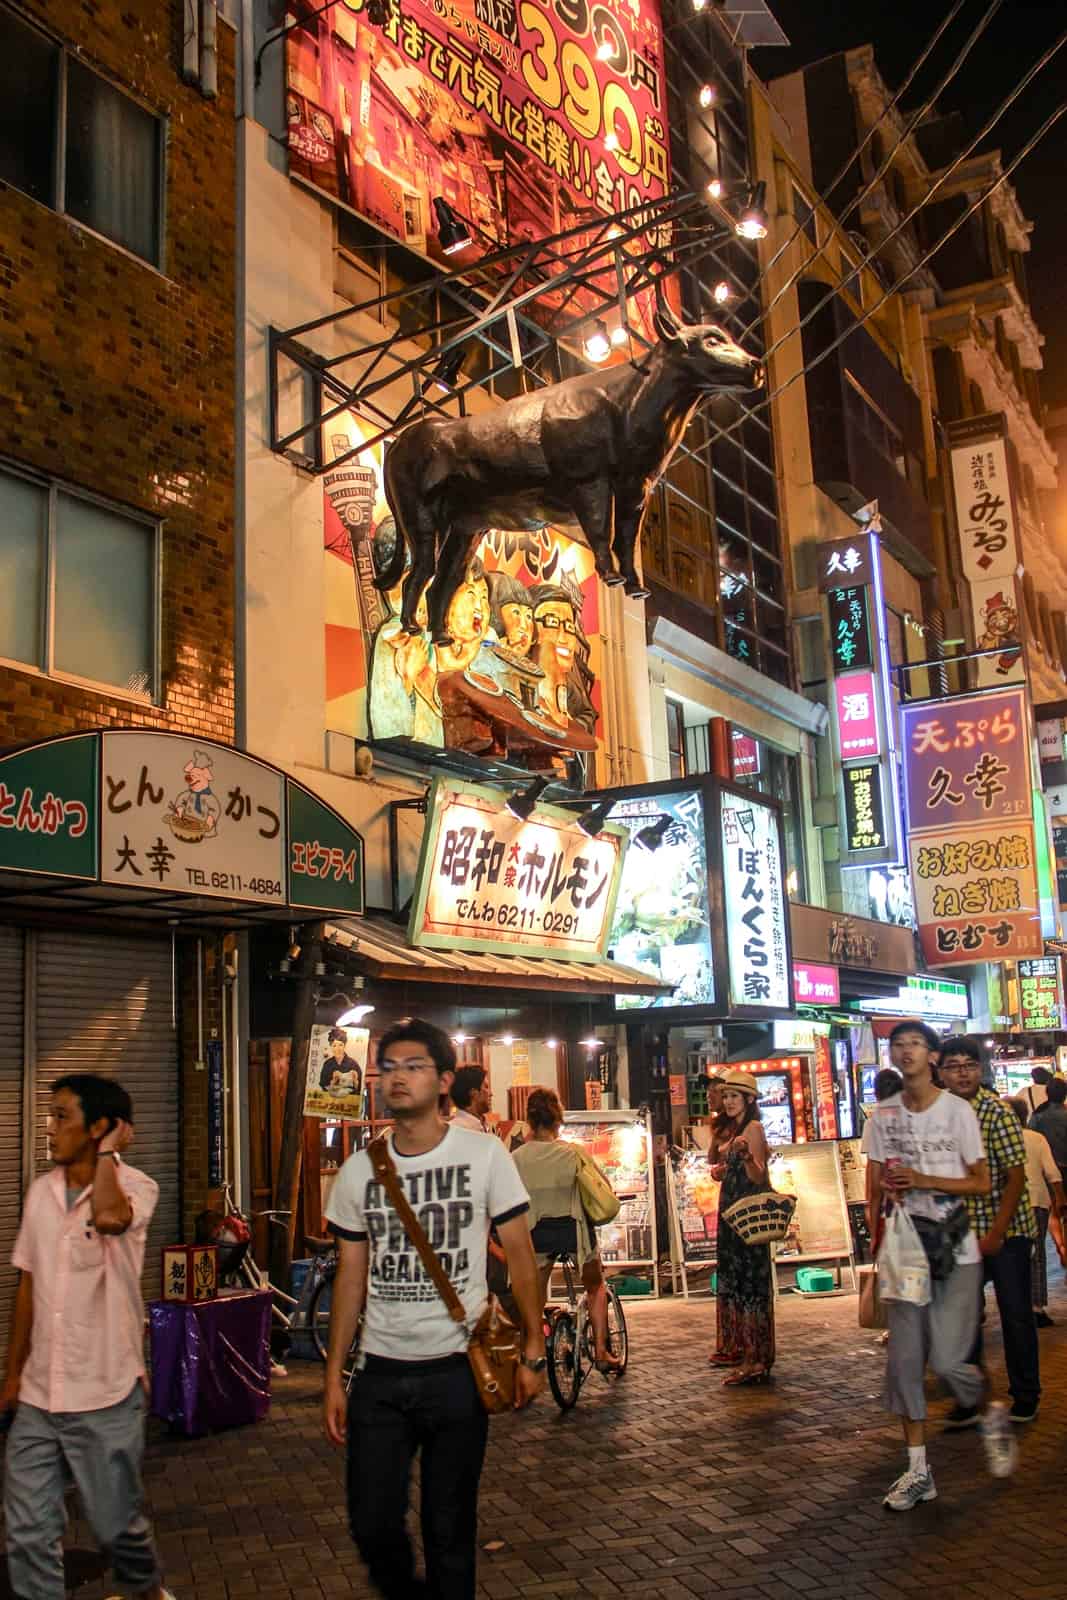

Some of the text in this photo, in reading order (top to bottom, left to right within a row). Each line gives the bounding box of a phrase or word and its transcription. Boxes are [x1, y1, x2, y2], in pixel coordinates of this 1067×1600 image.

[842, 693, 870, 721] 酒
[912, 708, 1016, 754] 天ぷら
[926, 753, 1008, 809] 久幸
[0, 783, 89, 838] とんかつ
[114, 835, 176, 882] 大幸
[439, 826, 608, 909] 昭和 大衆 ホルモン
[917, 835, 1031, 879] お好み焼
[456, 898, 495, 922] でんわ
[932, 877, 1021, 918] ねぎ焼
[737, 847, 772, 1000] ぼんくら家
[364, 1163, 472, 1210] ATIVE
